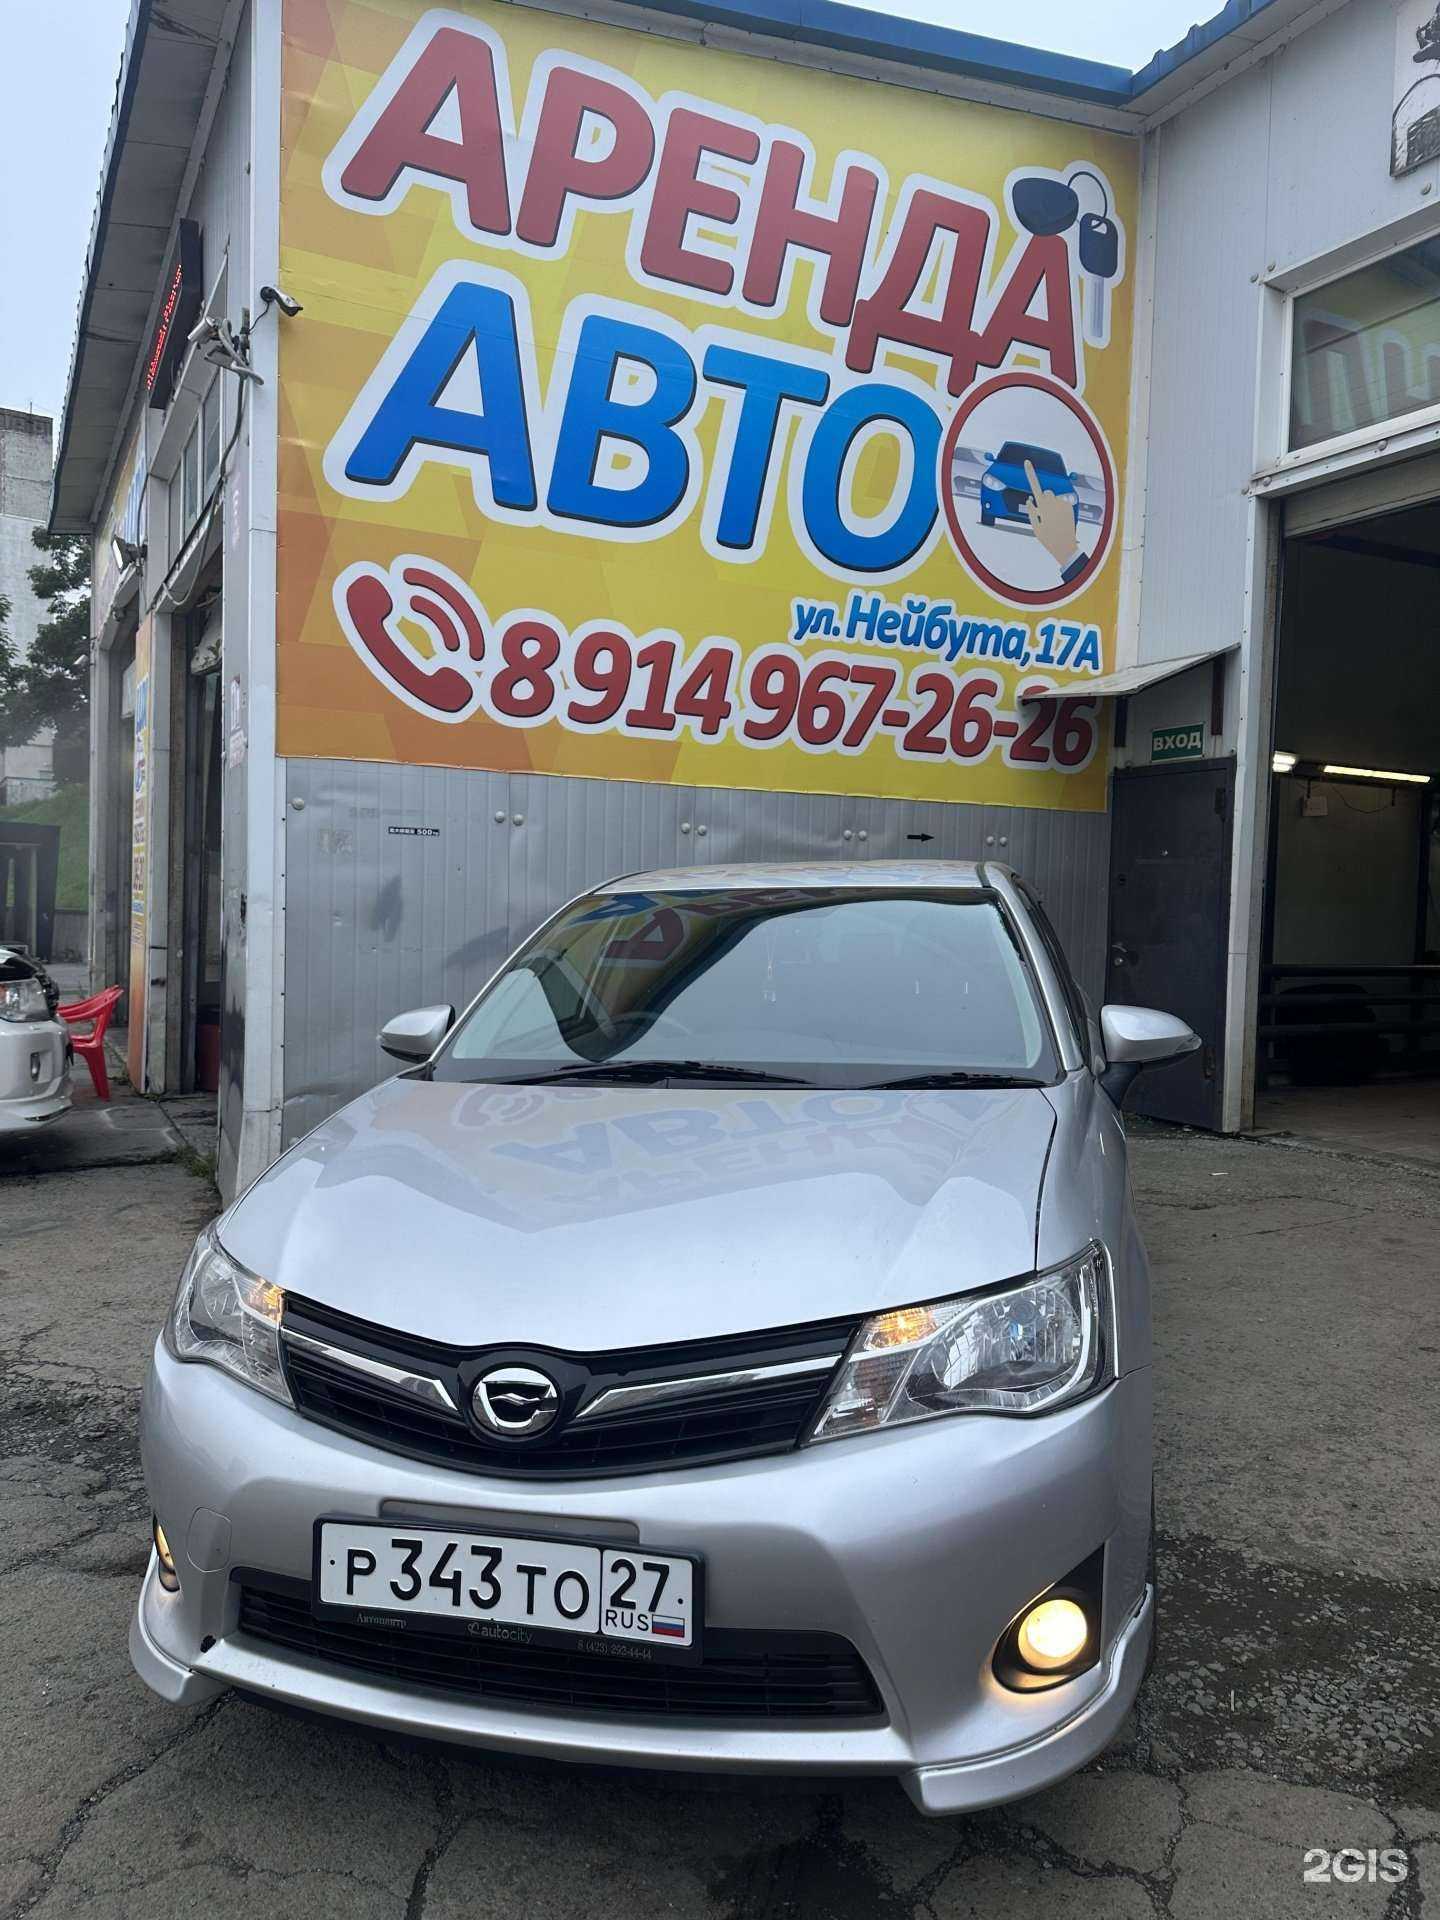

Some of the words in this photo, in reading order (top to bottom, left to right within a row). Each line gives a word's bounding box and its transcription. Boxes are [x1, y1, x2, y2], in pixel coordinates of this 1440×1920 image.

[340, 26, 1078, 396] АРЕНДА
[344, 281, 945, 573] АВТО
[745, 655, 1098, 766] 967-26-26
[1153, 731, 1201, 751] ВХОД
[609, 1558, 671, 1613] 27
[481, 1623, 533, 1644] autocity
[605, 1609, 649, 1633] RUS
